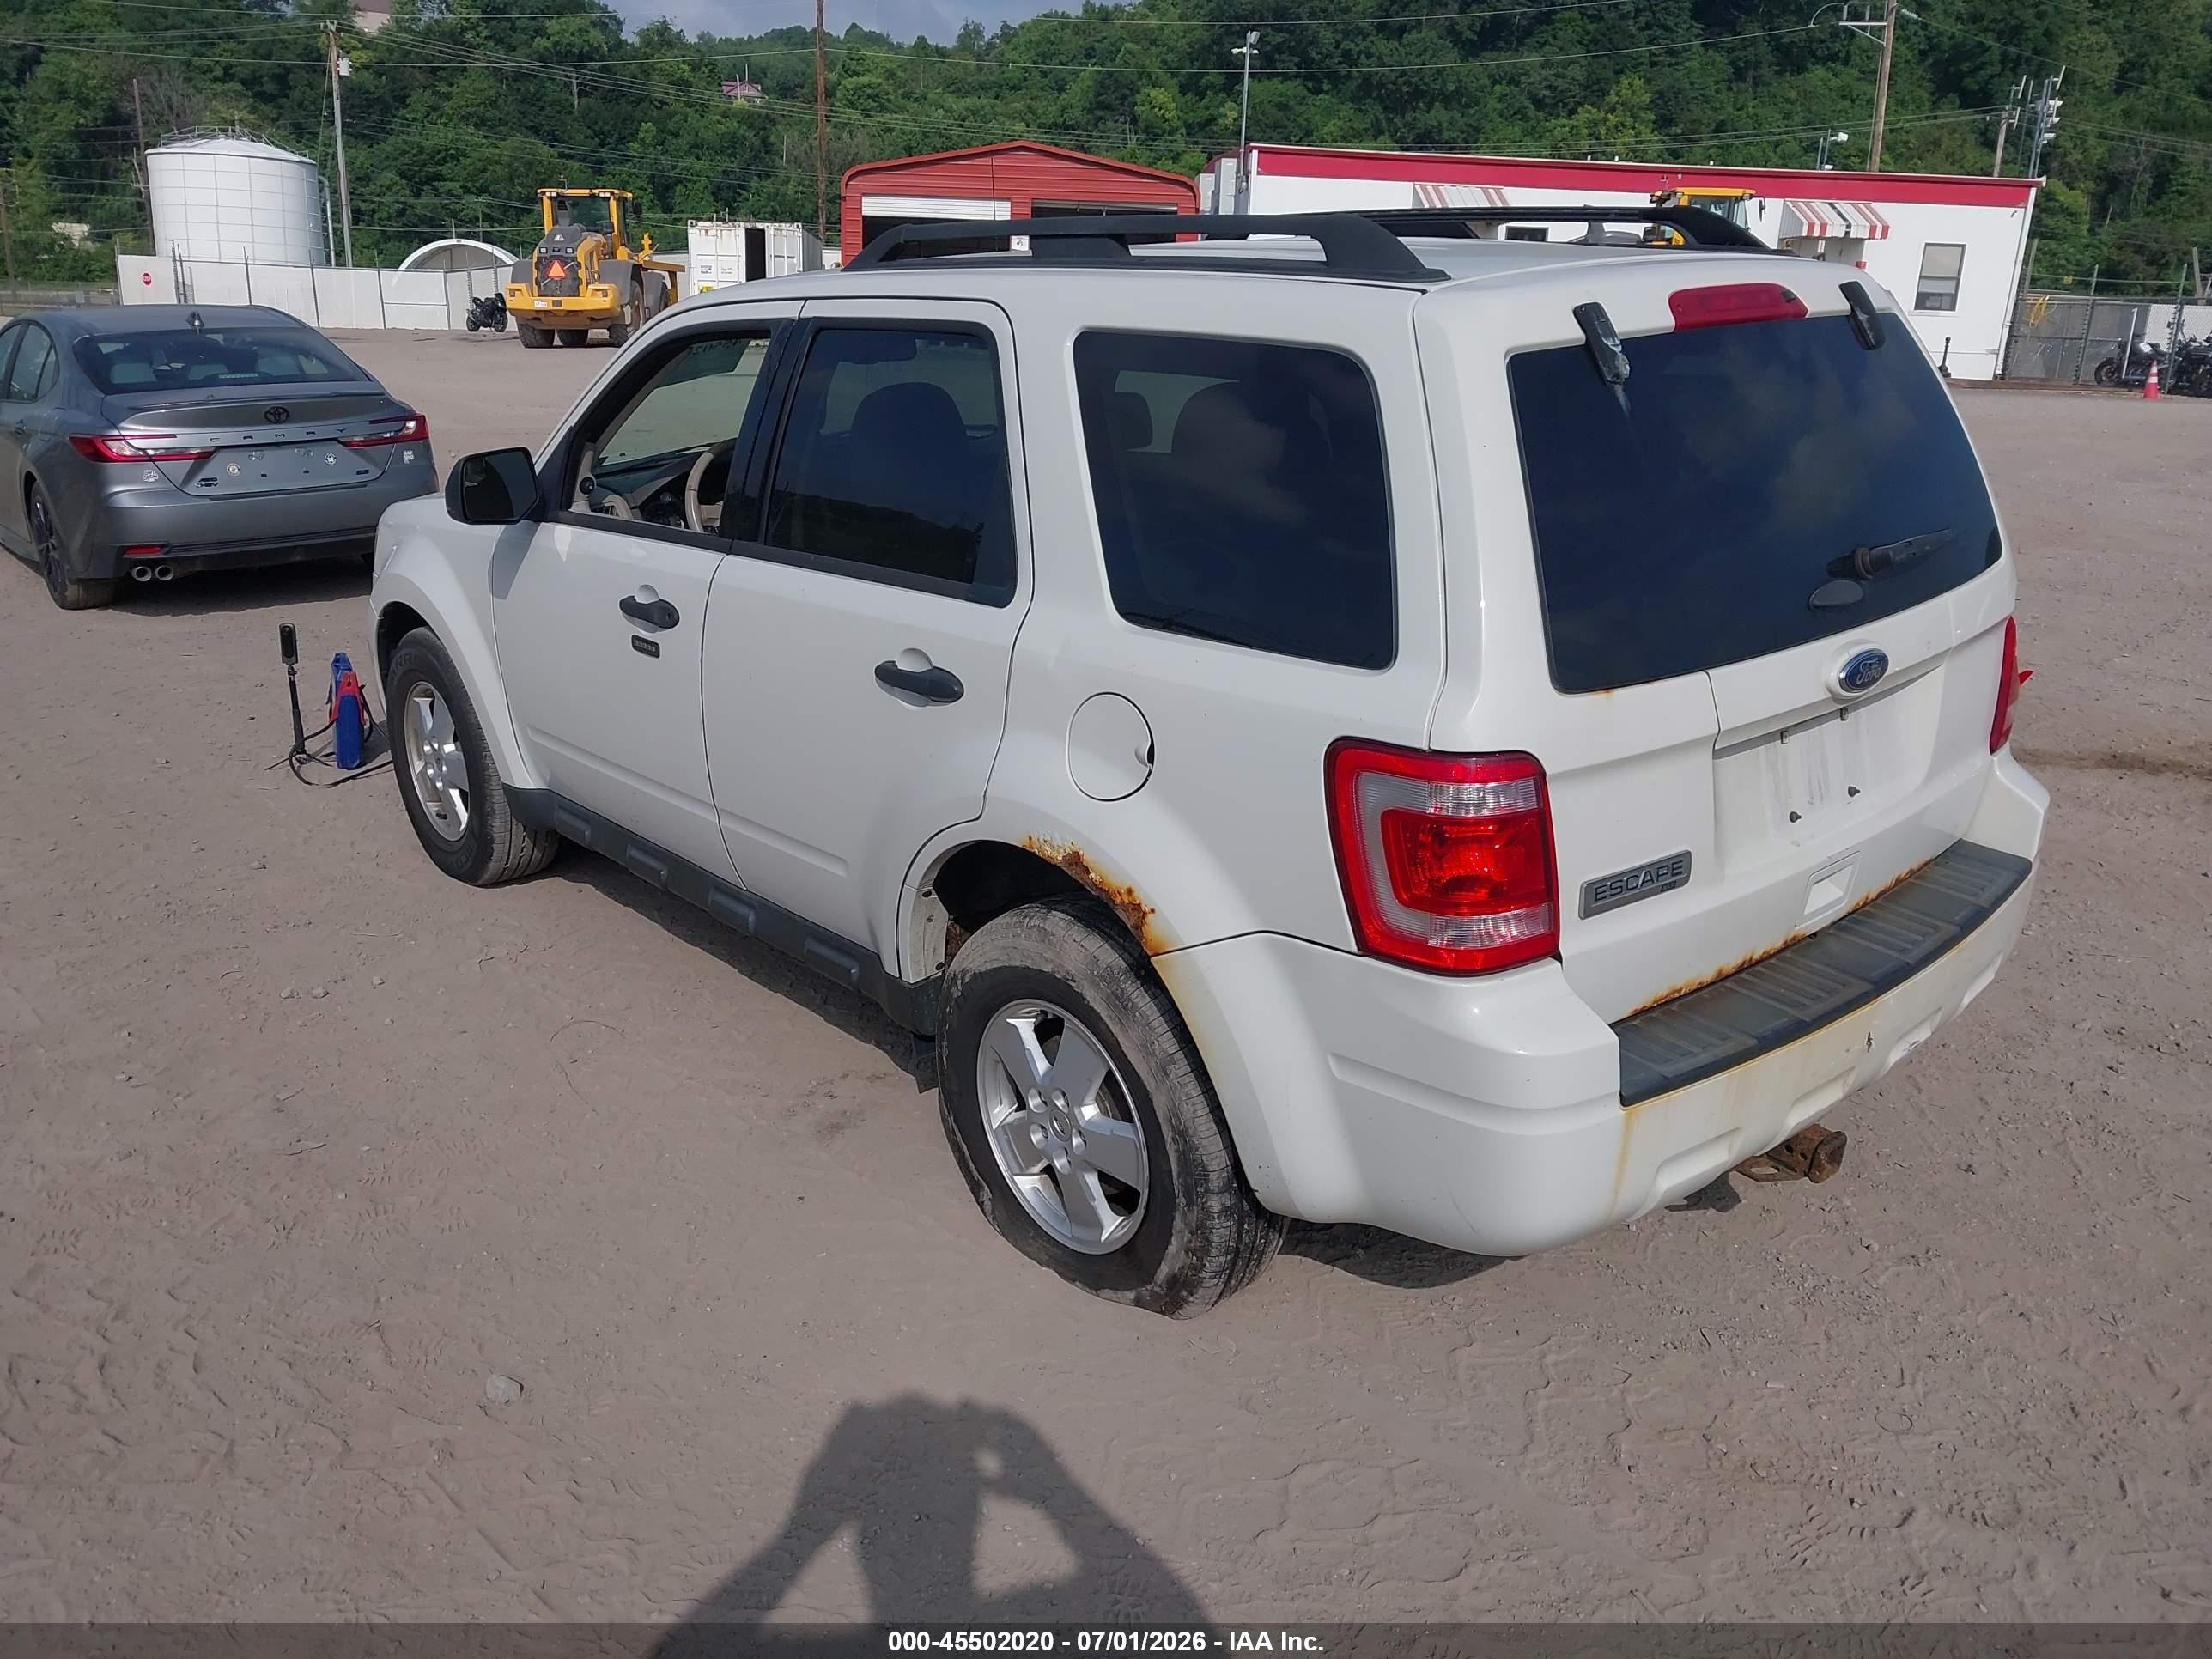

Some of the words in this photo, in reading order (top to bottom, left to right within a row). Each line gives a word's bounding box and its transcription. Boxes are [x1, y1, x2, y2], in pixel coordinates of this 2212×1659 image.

[210, 428, 346, 442] CAMRY
[1856, 657, 1883, 685] Ford
[1594, 860, 1684, 902] ESCAPE
